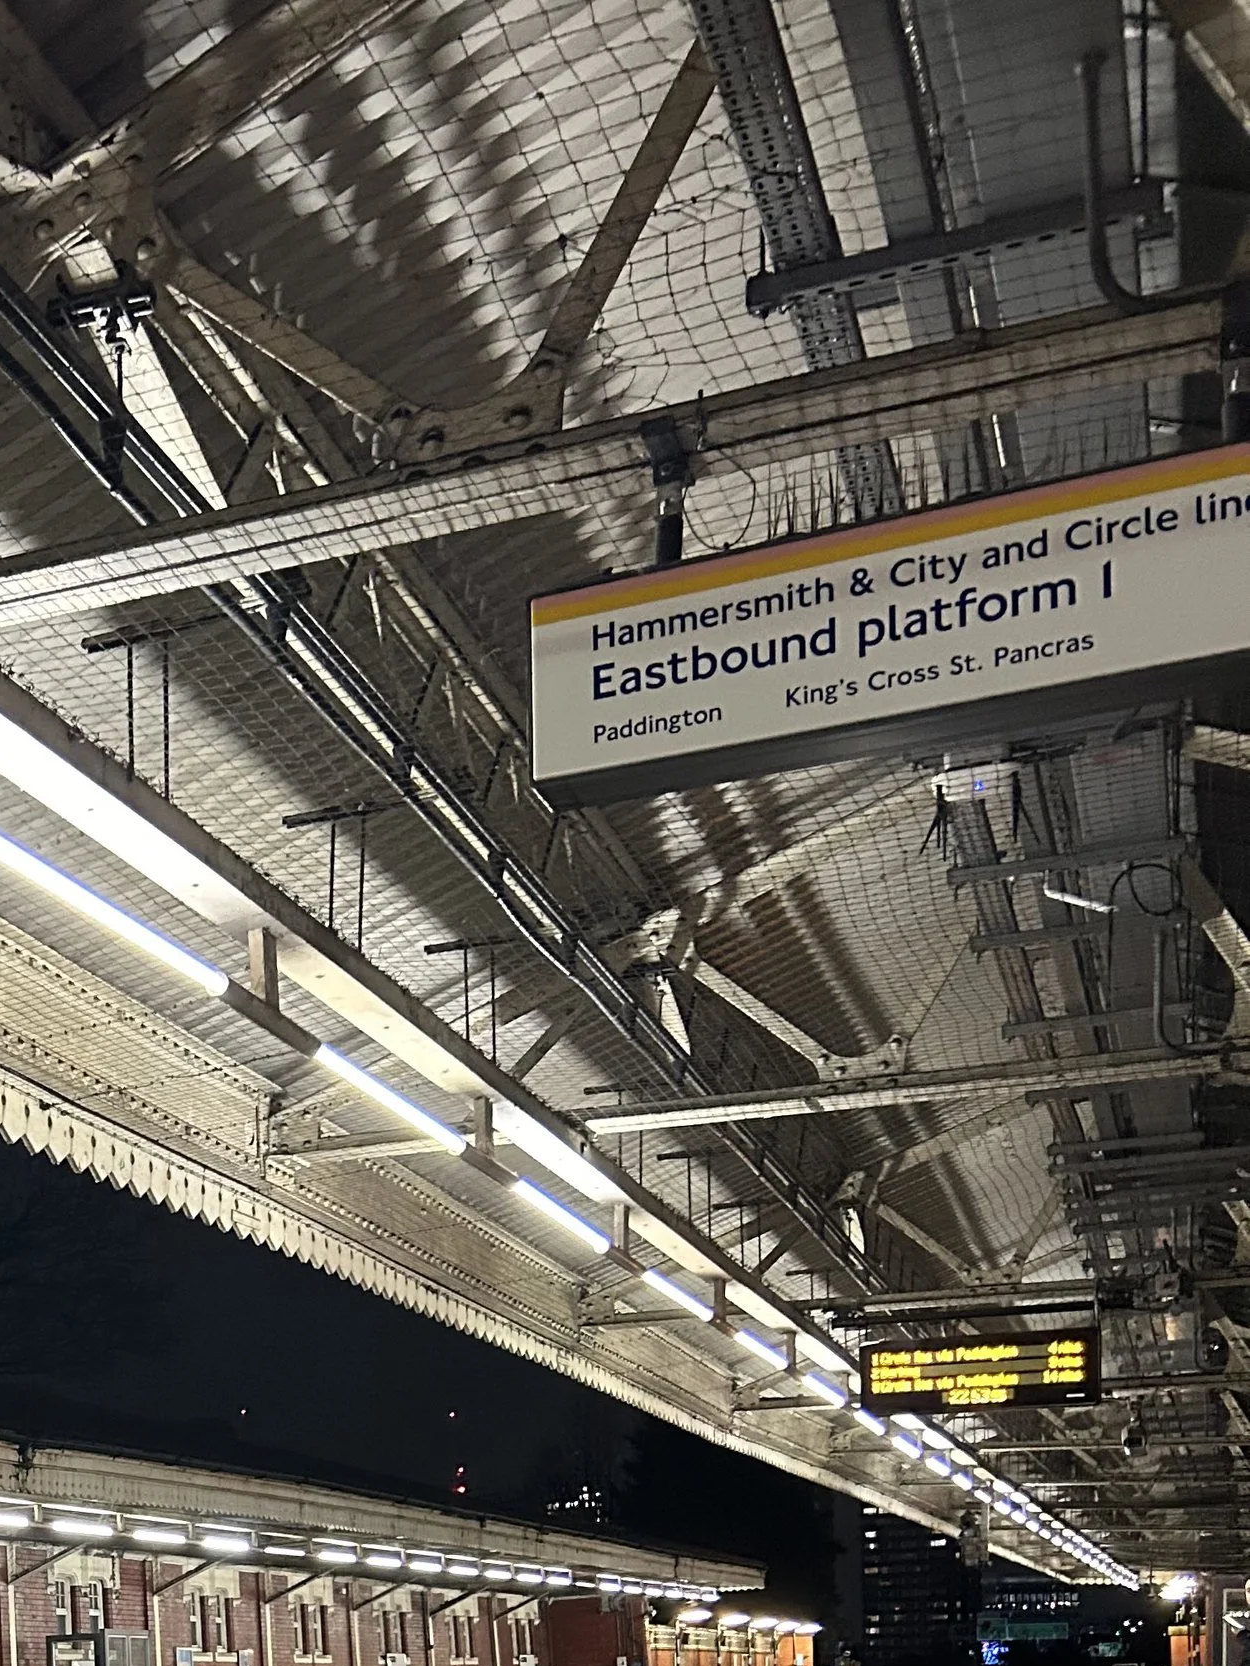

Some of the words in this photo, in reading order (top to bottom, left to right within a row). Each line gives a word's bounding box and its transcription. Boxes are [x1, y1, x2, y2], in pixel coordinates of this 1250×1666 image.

[592, 577, 835, 652] Hammersmith
[849, 568, 875, 597] &
[889, 552, 968, 588] City
[981, 527, 1049, 570] and
[1064, 506, 1179, 551] Circle
[1195, 492, 1250, 526] lin
[592, 616, 836, 701] Eastbound
[858, 579, 1077, 659] platform
[1102, 559, 1112, 599] 1
[785, 678, 859, 709] King's
[867, 664, 941, 692] Cross
[949, 652, 983, 676] St.
[994, 634, 1095, 668] Pancras
[593, 704, 723, 744] Paddington
